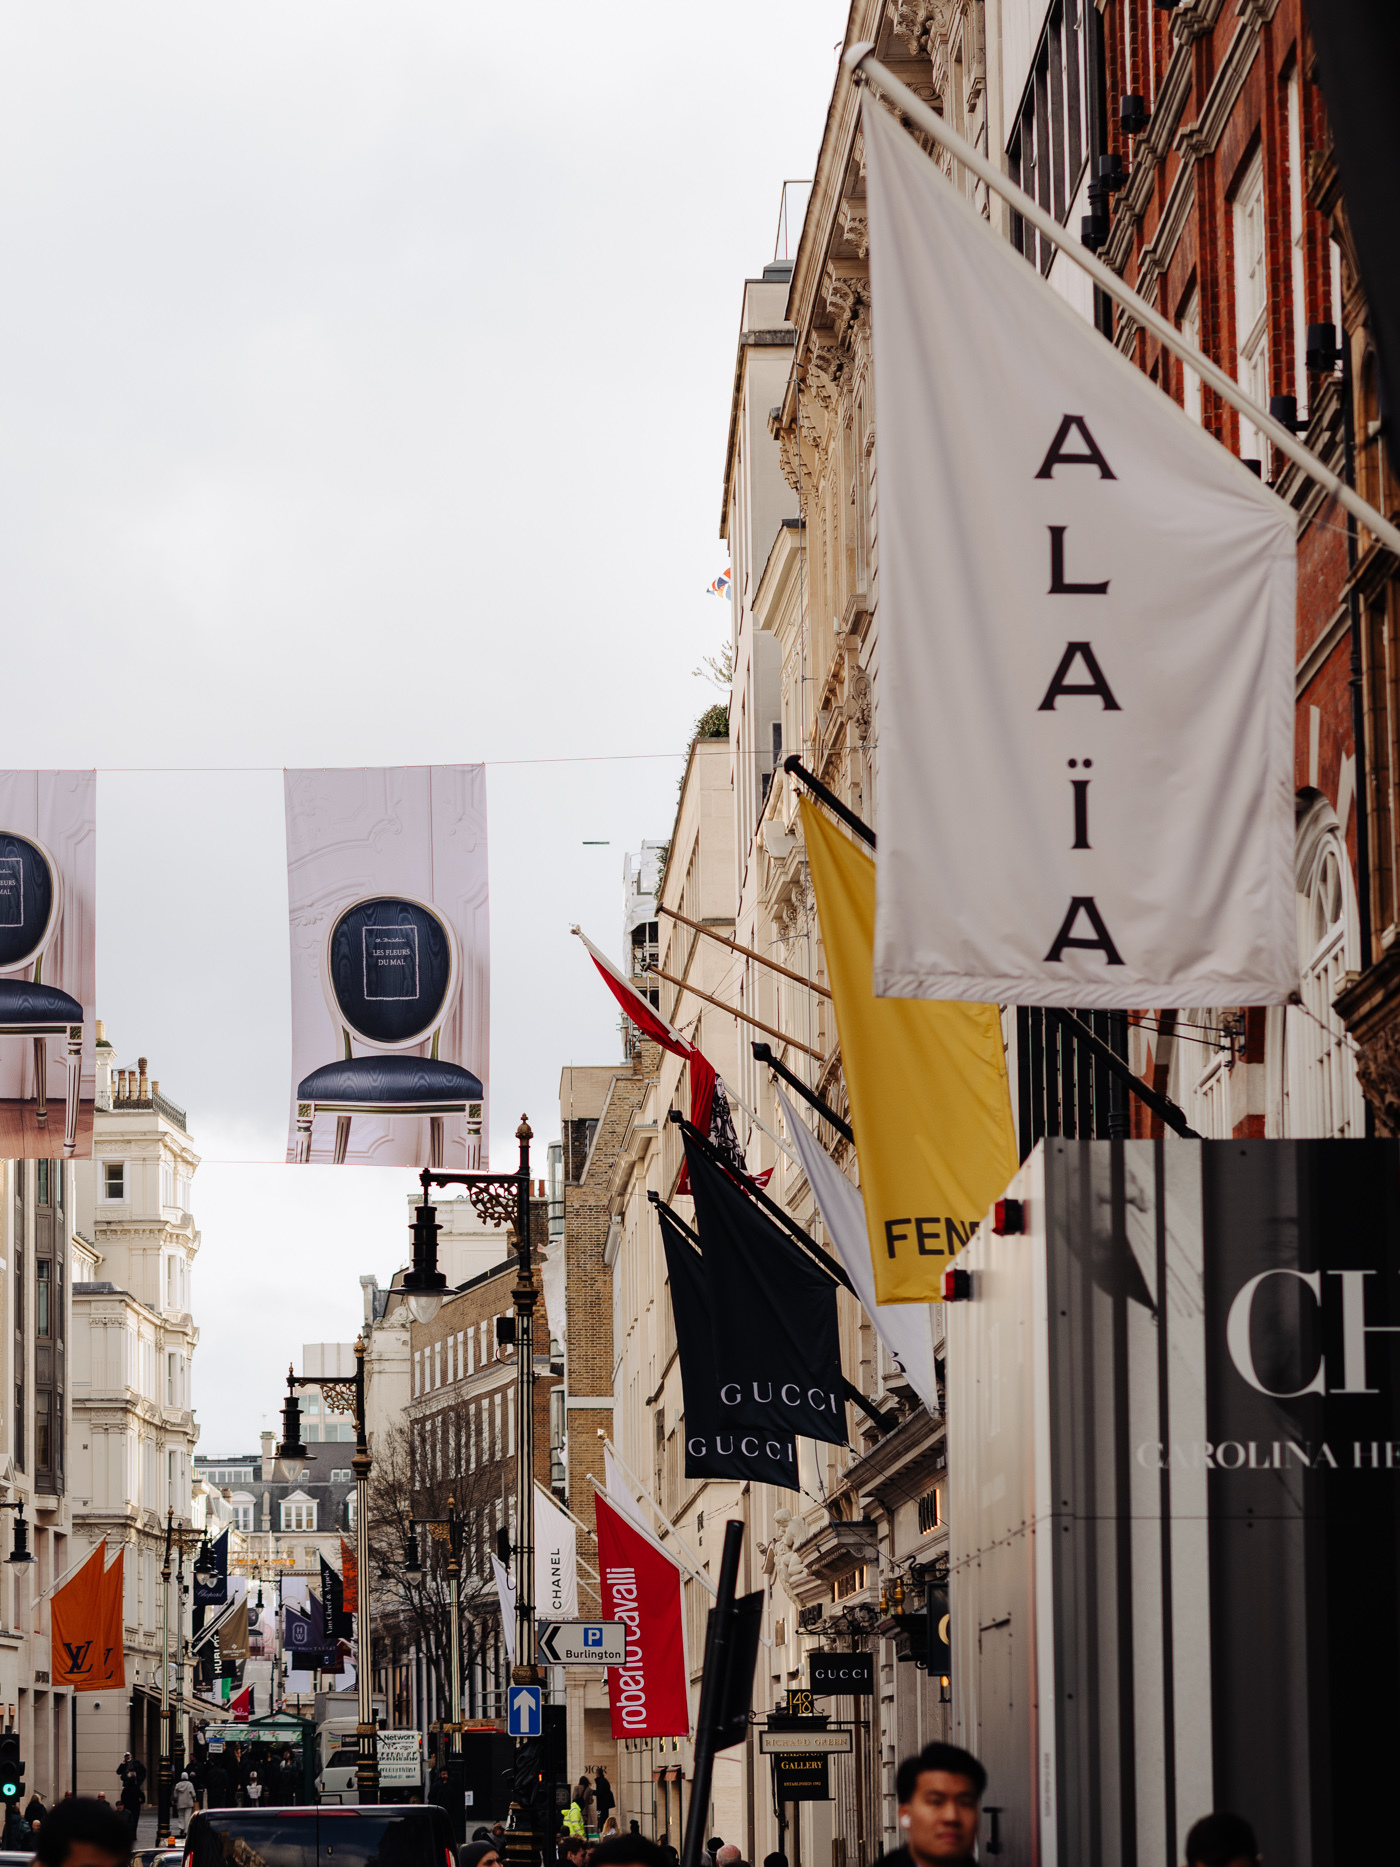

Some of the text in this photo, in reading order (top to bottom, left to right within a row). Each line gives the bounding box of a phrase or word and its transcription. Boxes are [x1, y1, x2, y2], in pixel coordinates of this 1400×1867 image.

[1033, 413, 1126, 966] ALAÏA
[385, 948, 410, 956] FLEURS
[390, 958, 406, 966] MAL
[720, 1381, 837, 1414] GUCCI
[688, 1435, 793, 1462] GUCCI
[1136, 1441, 1338, 1469] CAROLINA
[323, 1569, 333, 1593] Arpels
[550, 1548, 562, 1610] CHANEL
[325, 1602, 333, 1620] Cleef
[588, 1630, 601, 1645] P
[566, 1650, 621, 1661] Burlington
[815, 1669, 868, 1679] GUCCI
[788, 1691, 812, 1715] 148
[765, 1737, 848, 1747] RICHARD GREEN
[780, 1760, 823, 1770] GALLERY
